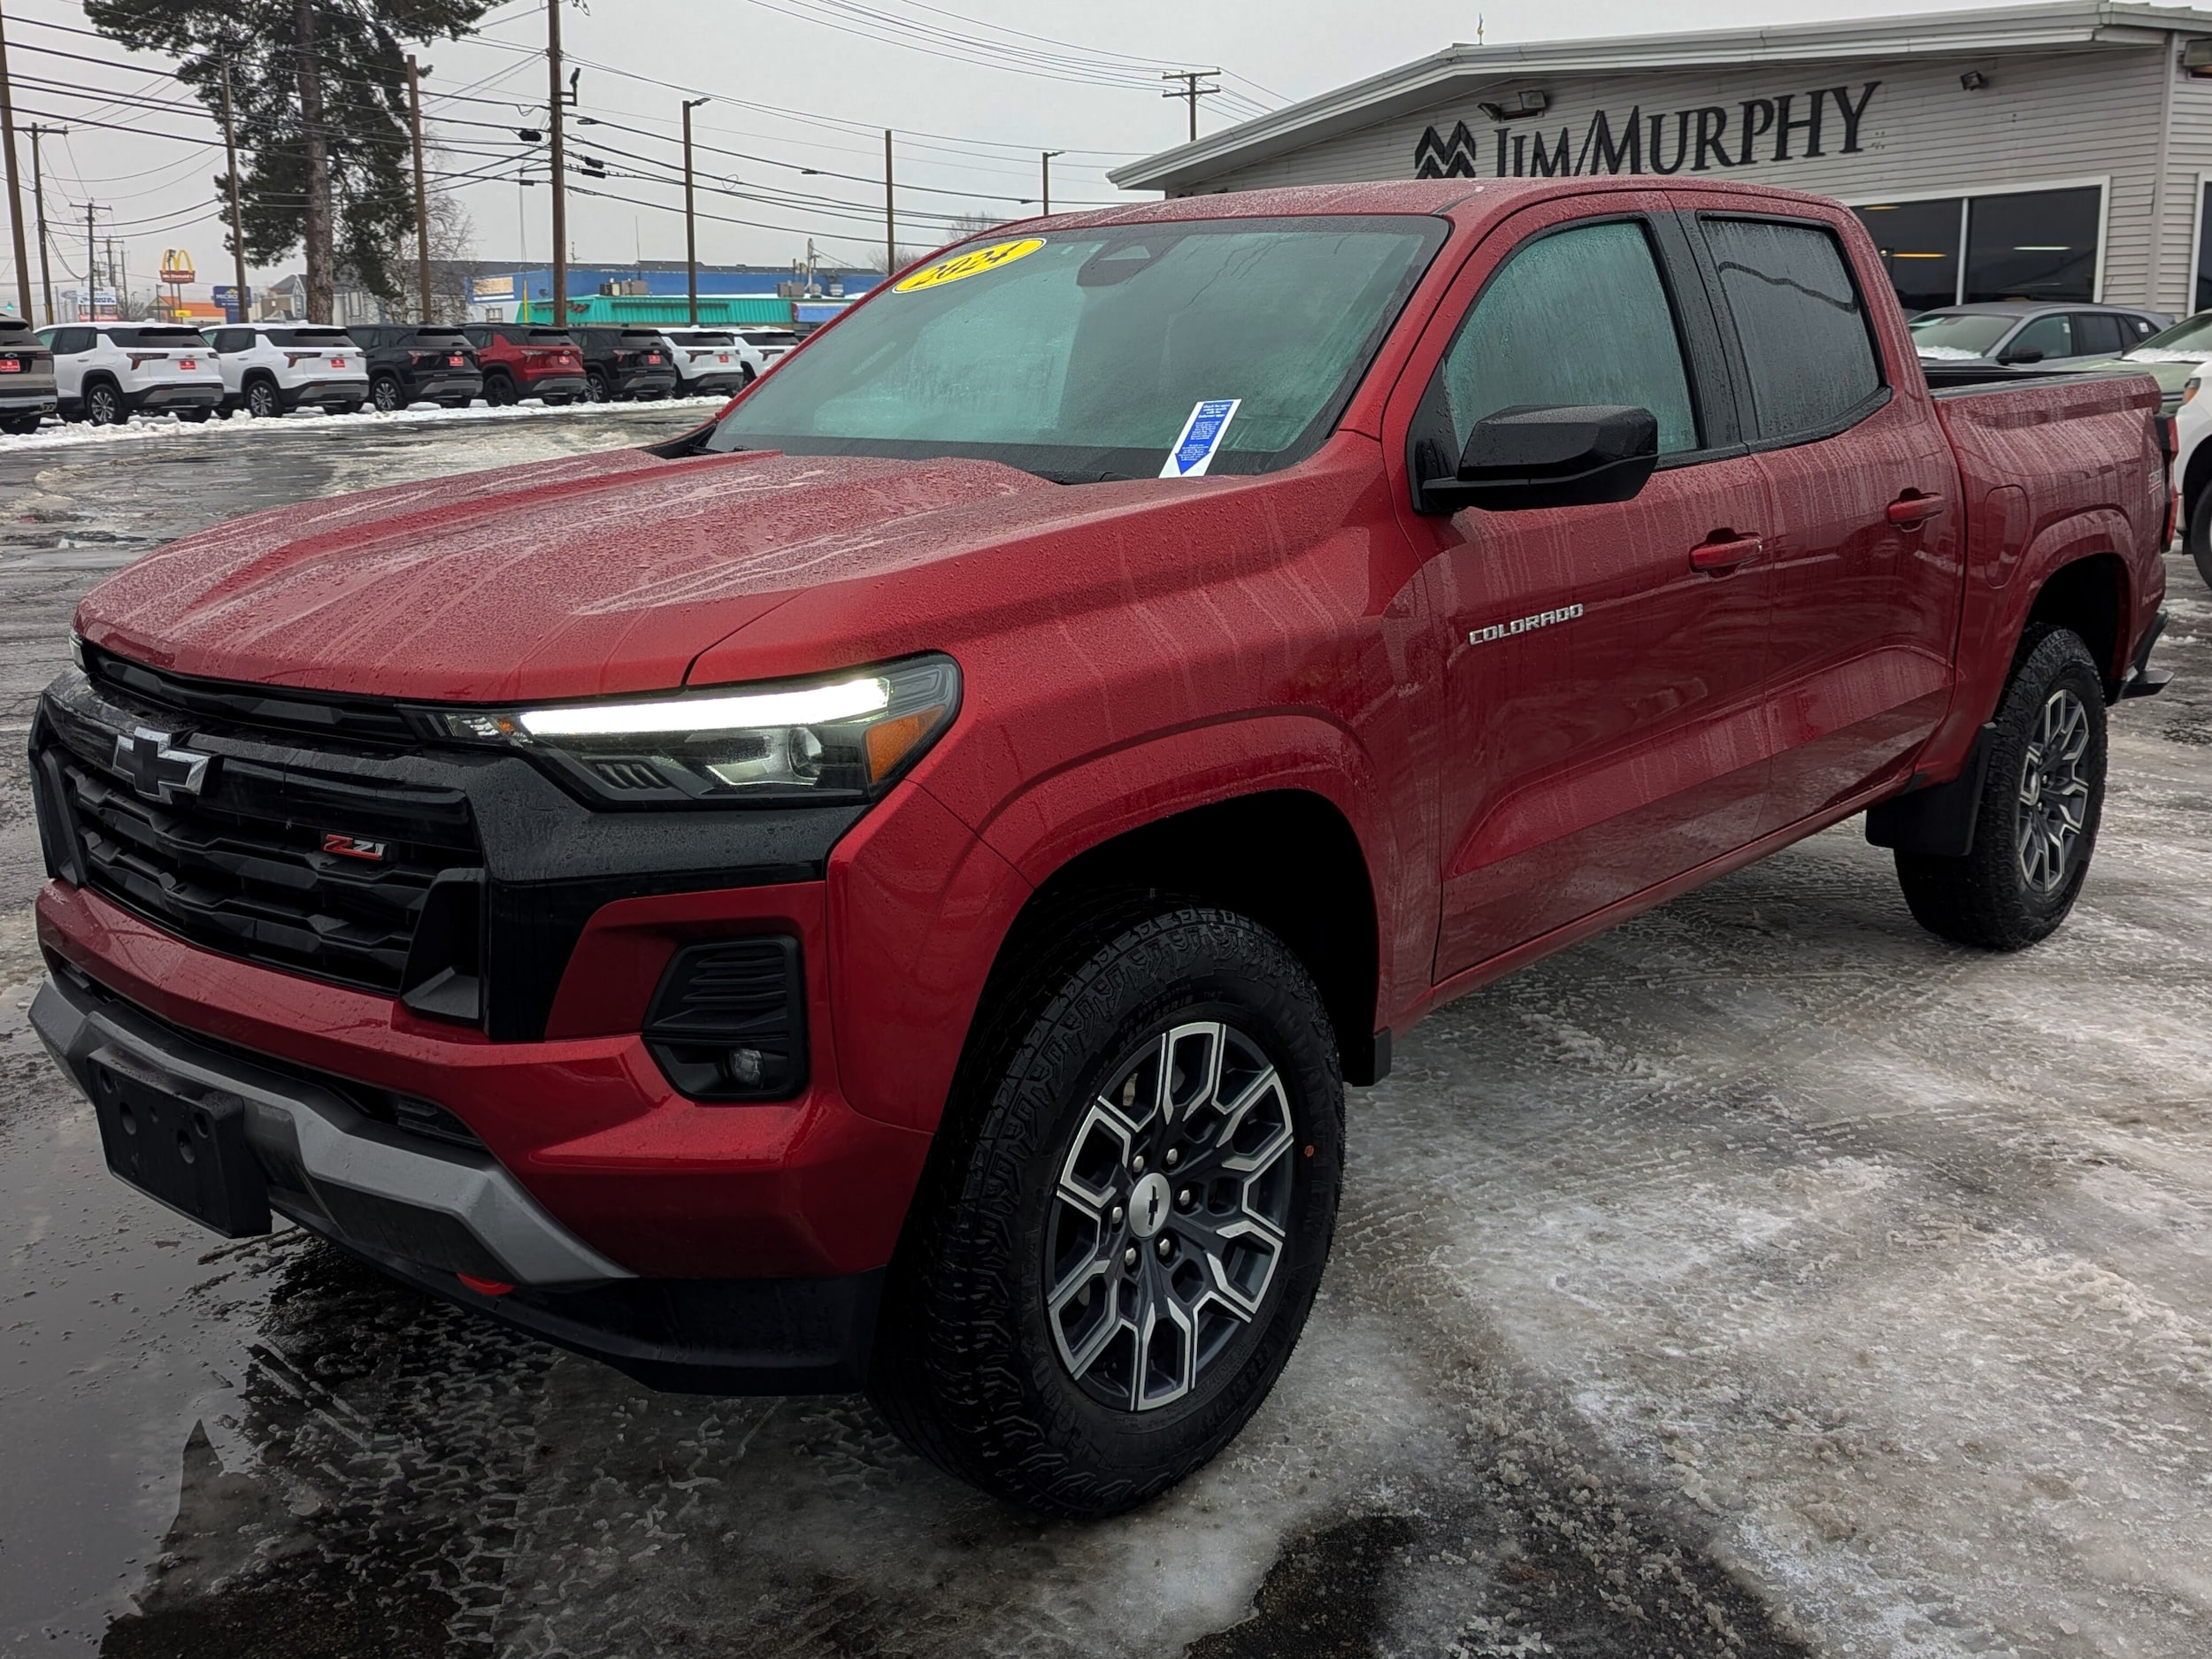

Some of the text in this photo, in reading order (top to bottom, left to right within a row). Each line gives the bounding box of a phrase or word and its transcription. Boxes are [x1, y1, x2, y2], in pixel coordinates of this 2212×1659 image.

[1589, 81, 1881, 175] MURPHY
[908, 241, 1024, 288] 2024
[1469, 603, 1584, 645] COLORADO
